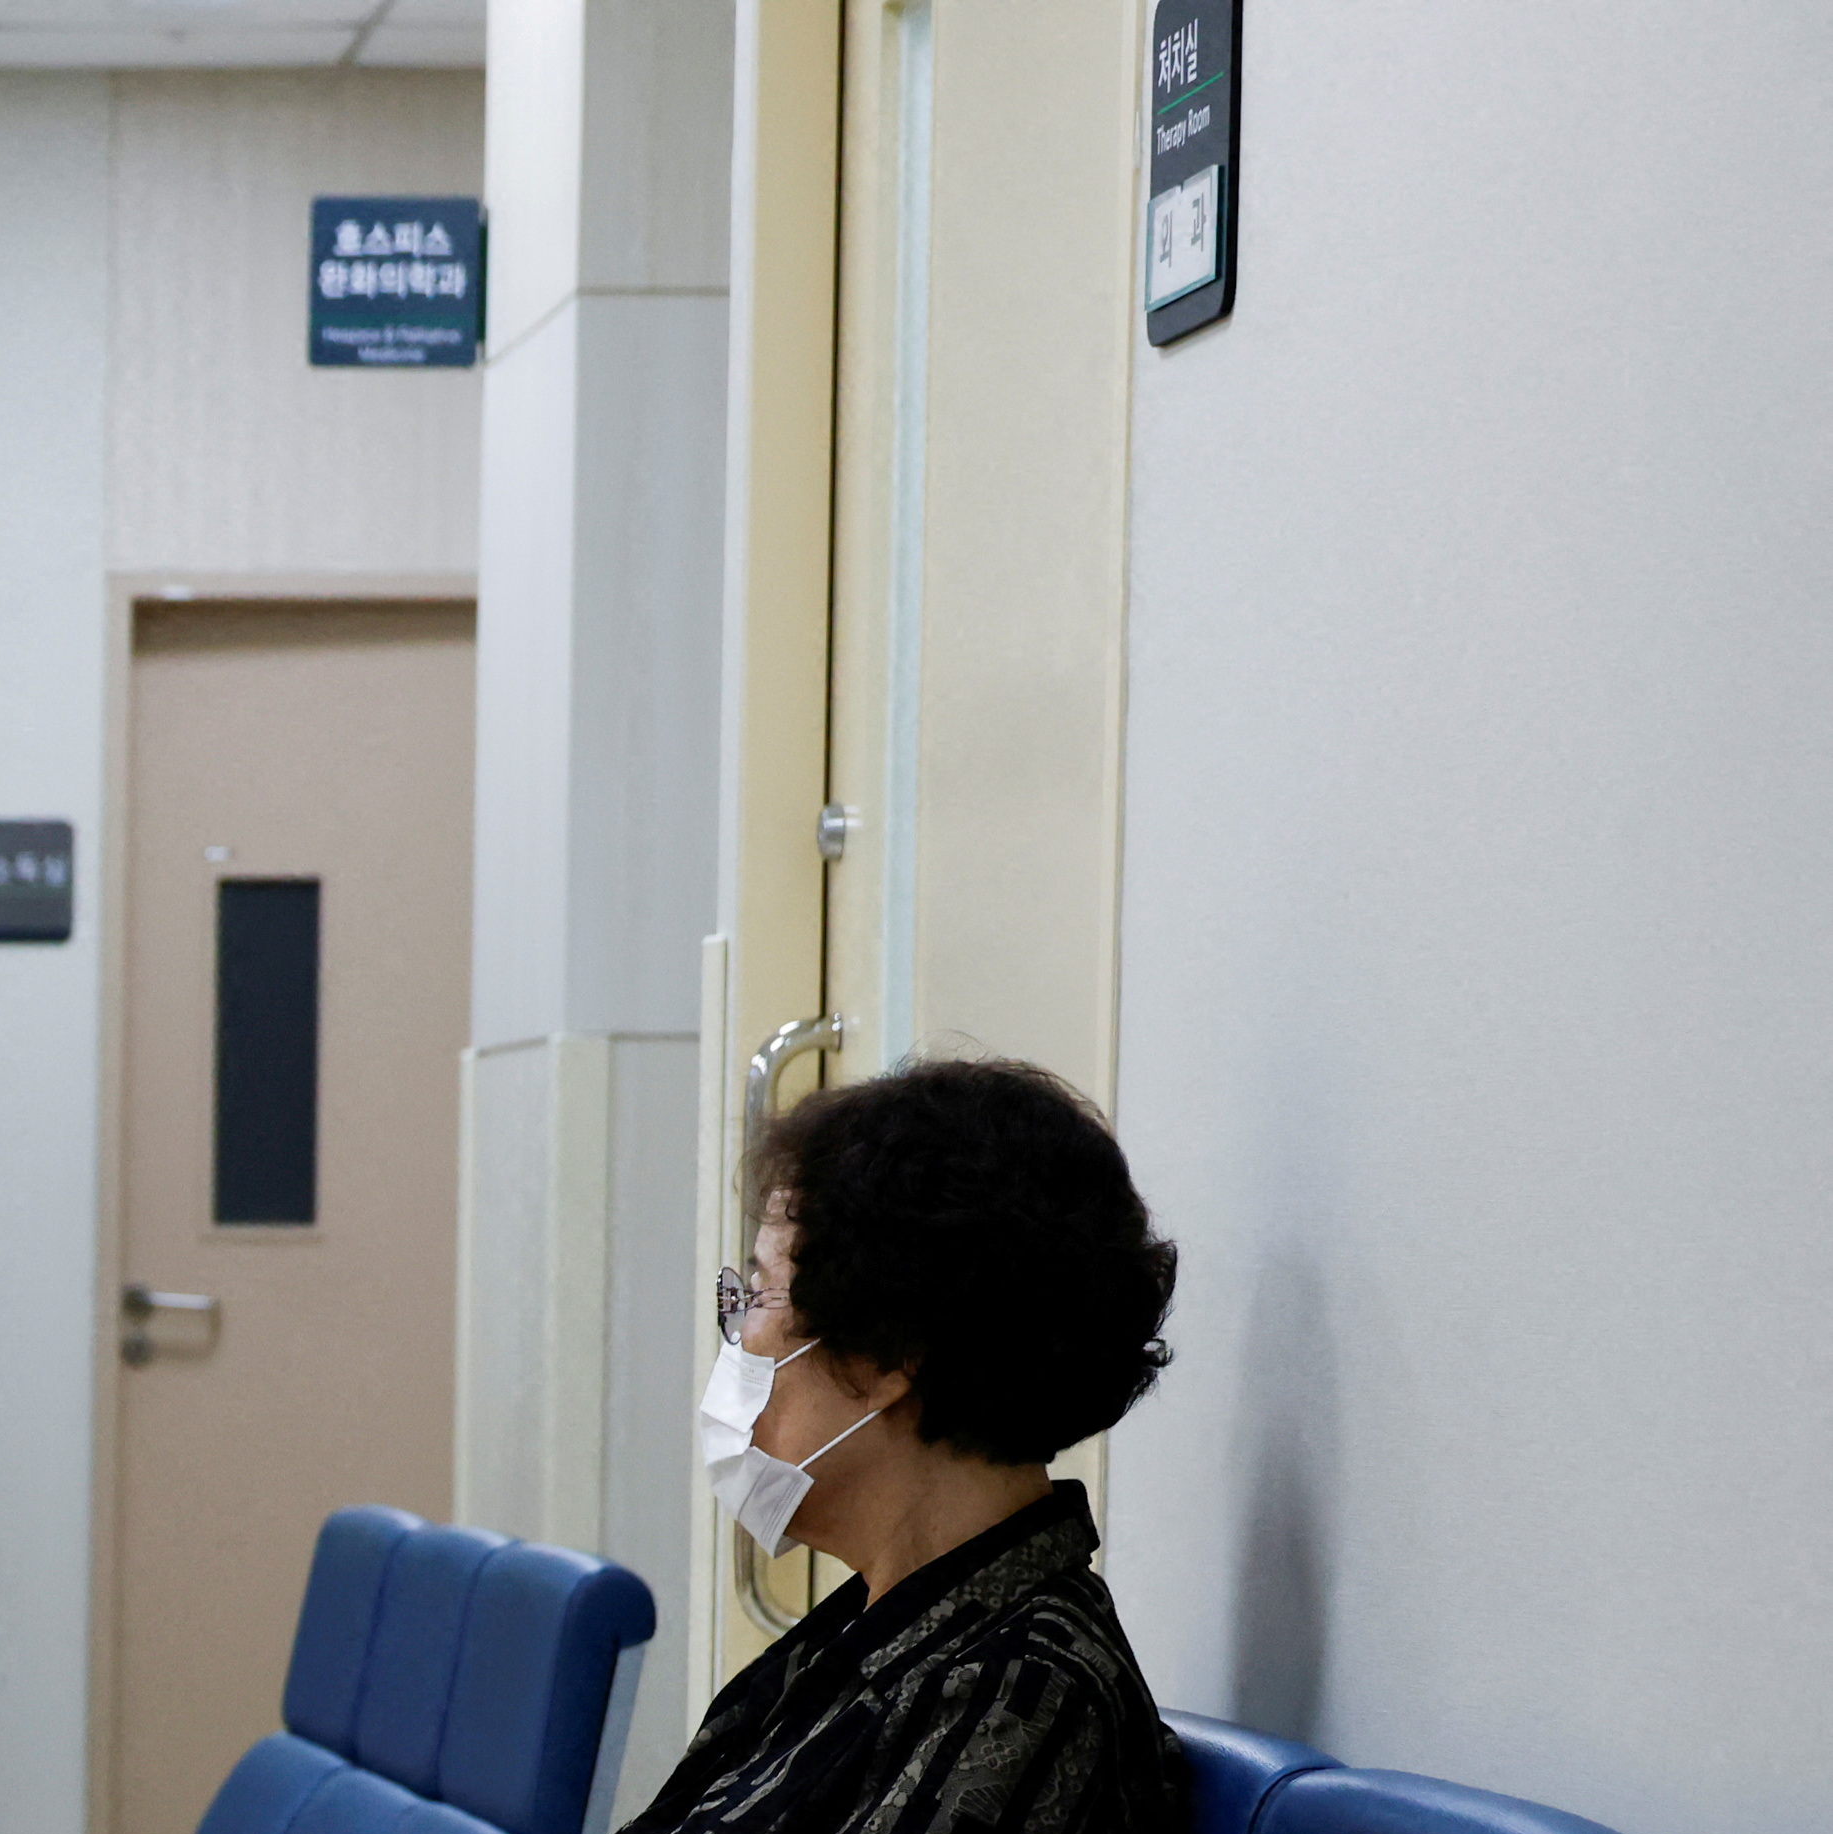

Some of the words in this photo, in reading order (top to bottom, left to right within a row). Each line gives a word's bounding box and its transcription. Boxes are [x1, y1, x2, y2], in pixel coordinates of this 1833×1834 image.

[1158, 17, 1199, 94] 처치실
[1156, 118, 1186, 156] Therapy
[1187, 104, 1211, 137] Room
[333, 219, 453, 257] 호스피스
